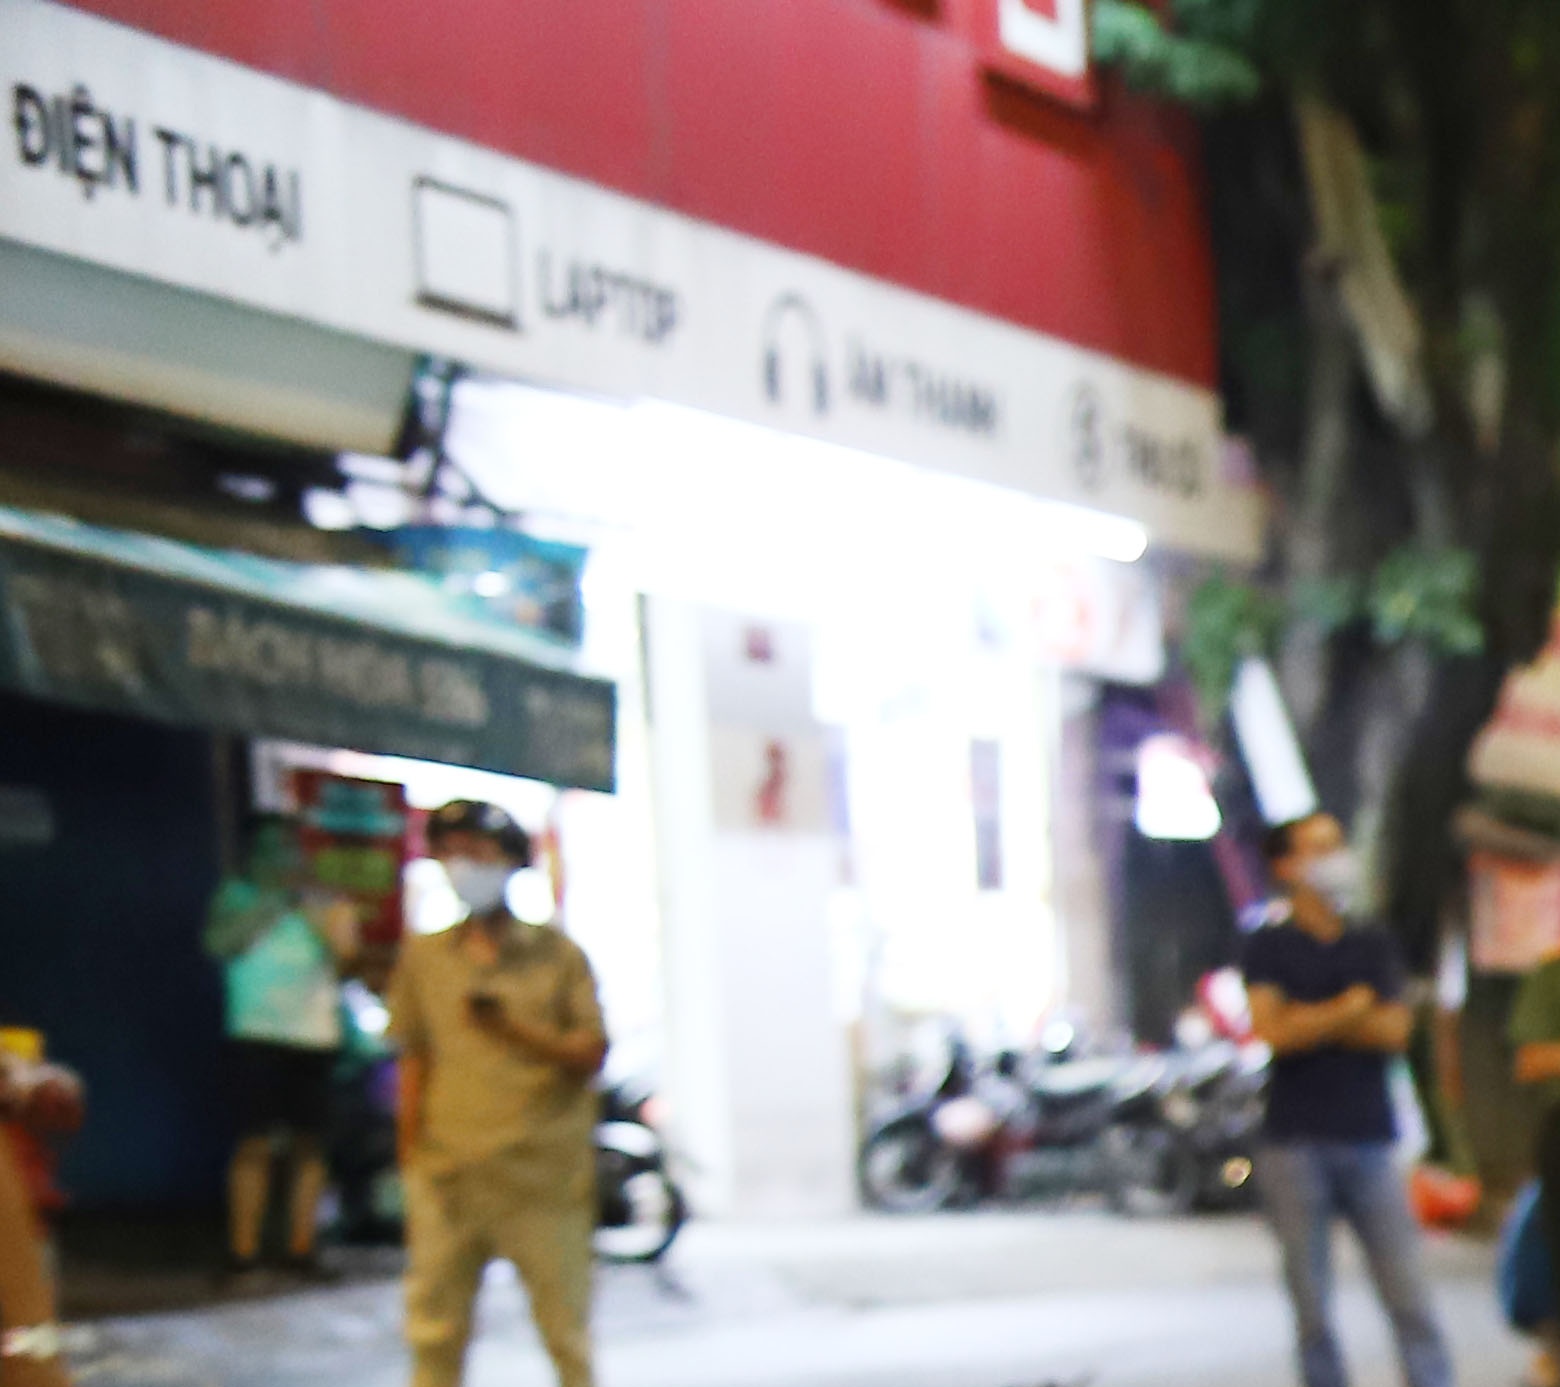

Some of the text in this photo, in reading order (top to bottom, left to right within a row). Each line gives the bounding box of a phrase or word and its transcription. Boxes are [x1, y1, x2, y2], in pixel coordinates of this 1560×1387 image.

[11, 82, 301, 254] ĐIỆN THOẠI
[537, 245, 679, 346] LAPTOP
